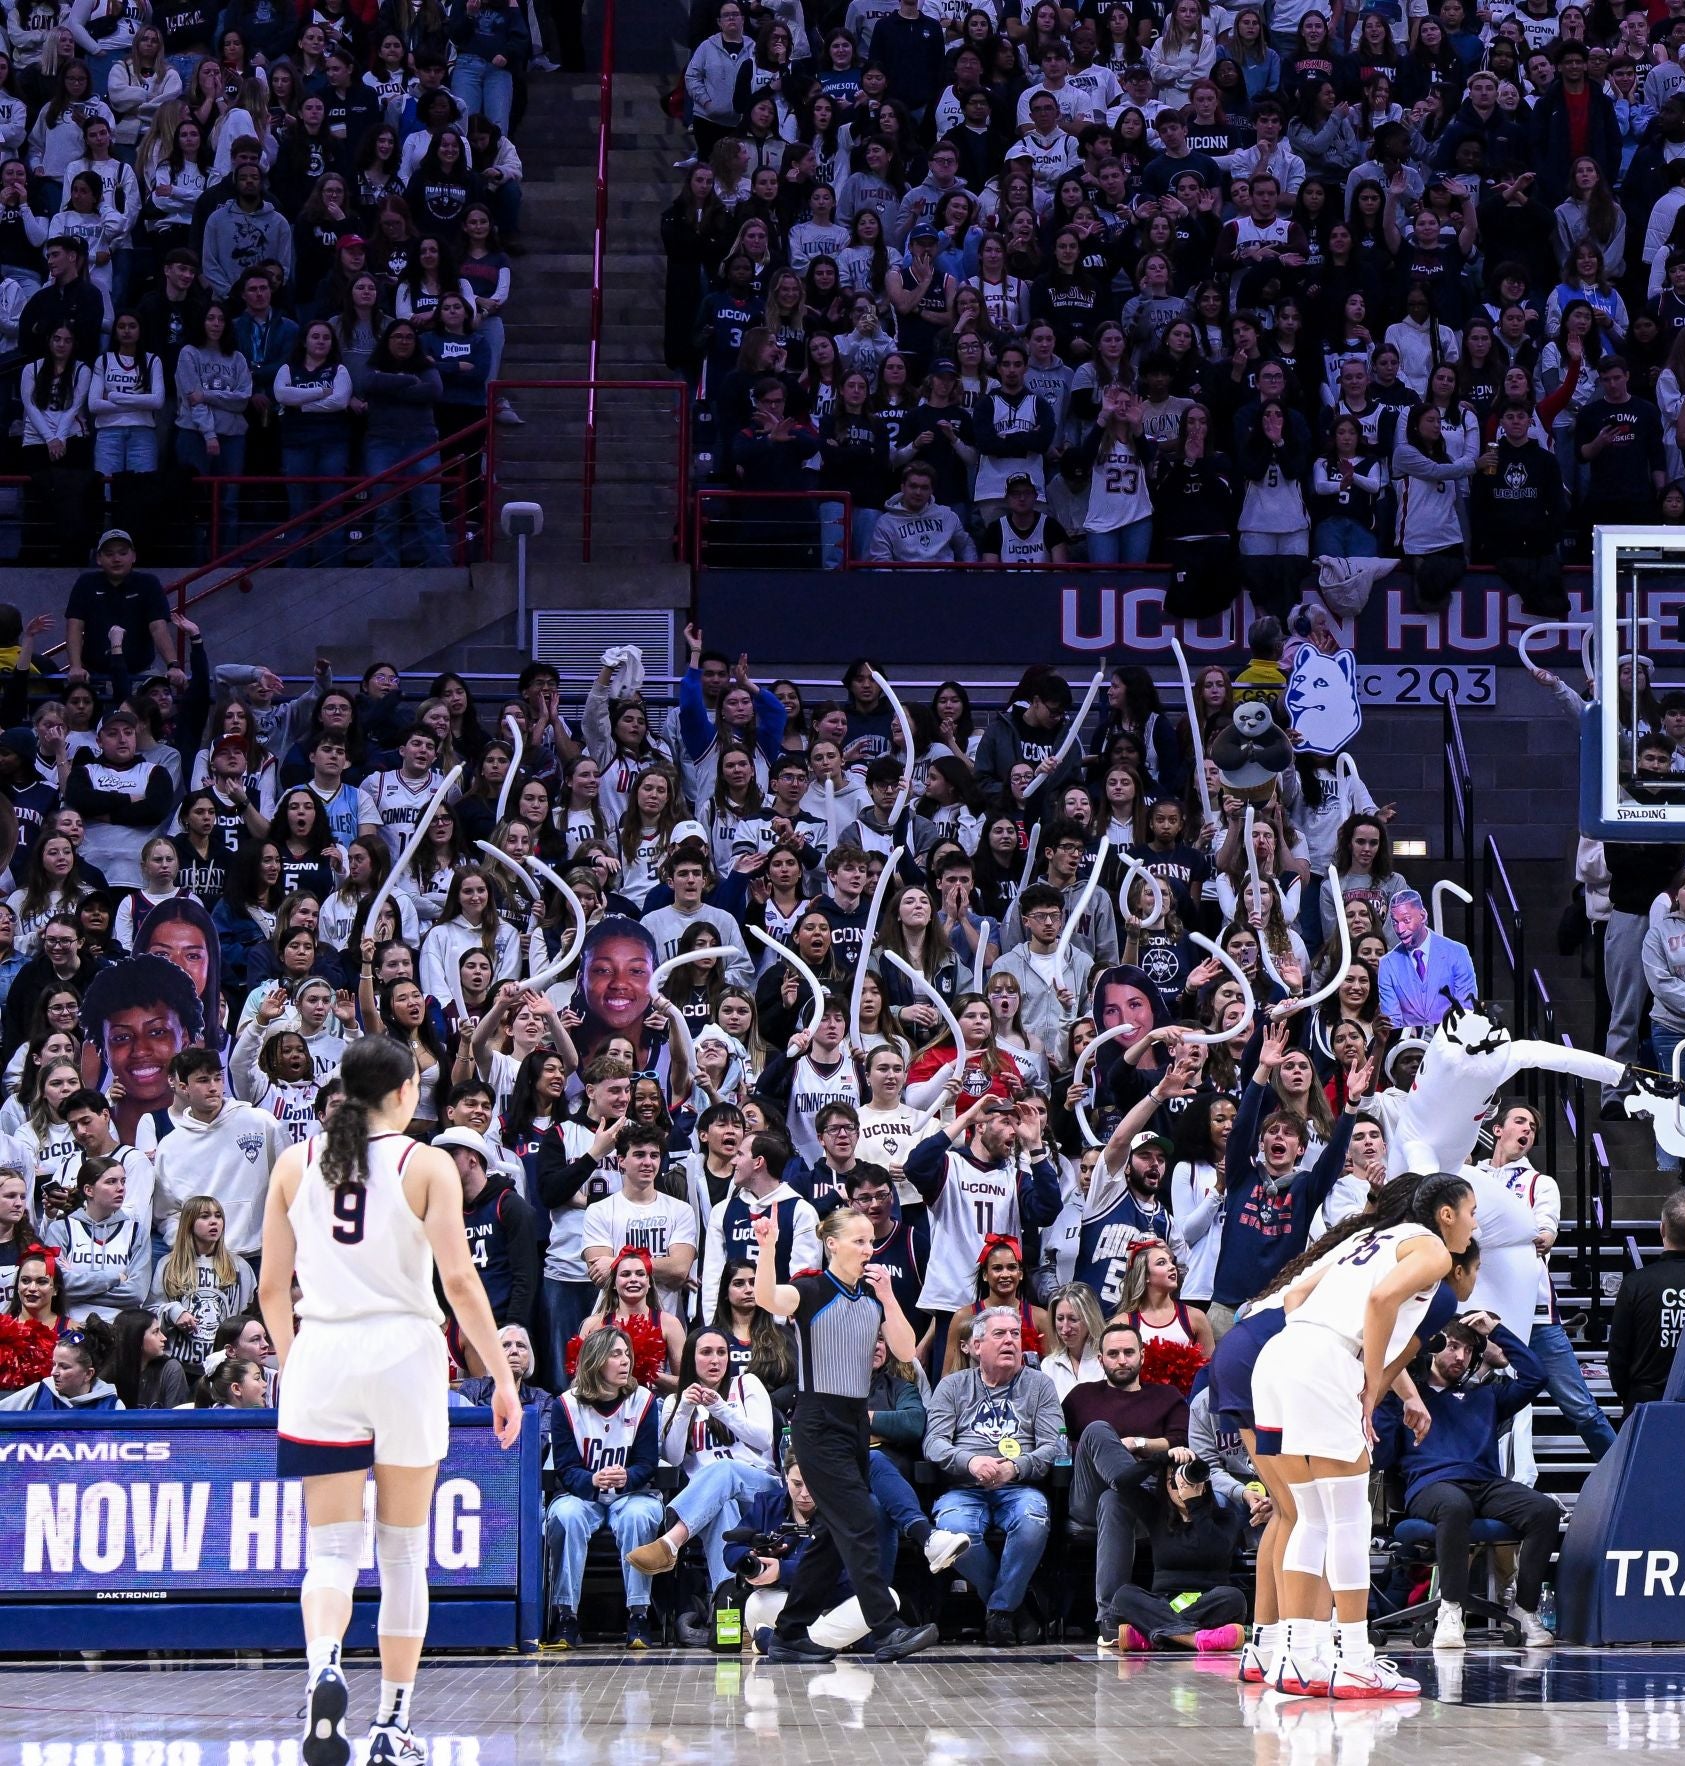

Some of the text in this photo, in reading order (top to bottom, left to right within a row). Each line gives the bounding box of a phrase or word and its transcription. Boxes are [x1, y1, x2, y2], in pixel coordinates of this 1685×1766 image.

[1186, 135, 1229, 148] UCONN
[729, 329, 741, 345] 3
[1107, 469, 1137, 494] 23
[1267, 470, 1279, 488] 5
[1493, 487, 1538, 500] UCONN
[899, 521, 943, 538] UCONN
[1008, 543, 1043, 555] UCONN
[1397, 667, 1491, 703] 203
[1618, 808, 1667, 820] SPALDING
[225, 829, 239, 852] 5
[284, 874, 299, 891] 5
[289, 1122, 307, 1143] 35
[863, 1124, 911, 1137] UCONN
[962, 1182, 1005, 1196] UCONN
[332, 1184, 365, 1244] 9
[974, 1201, 993, 1234] 11
[74, 1252, 128, 1264] UCONN
[1104, 1255, 1127, 1303] 5
[23, 1479, 481, 1573] NOW HIG
[97, 1590, 167, 1600] DAKTRONICS
